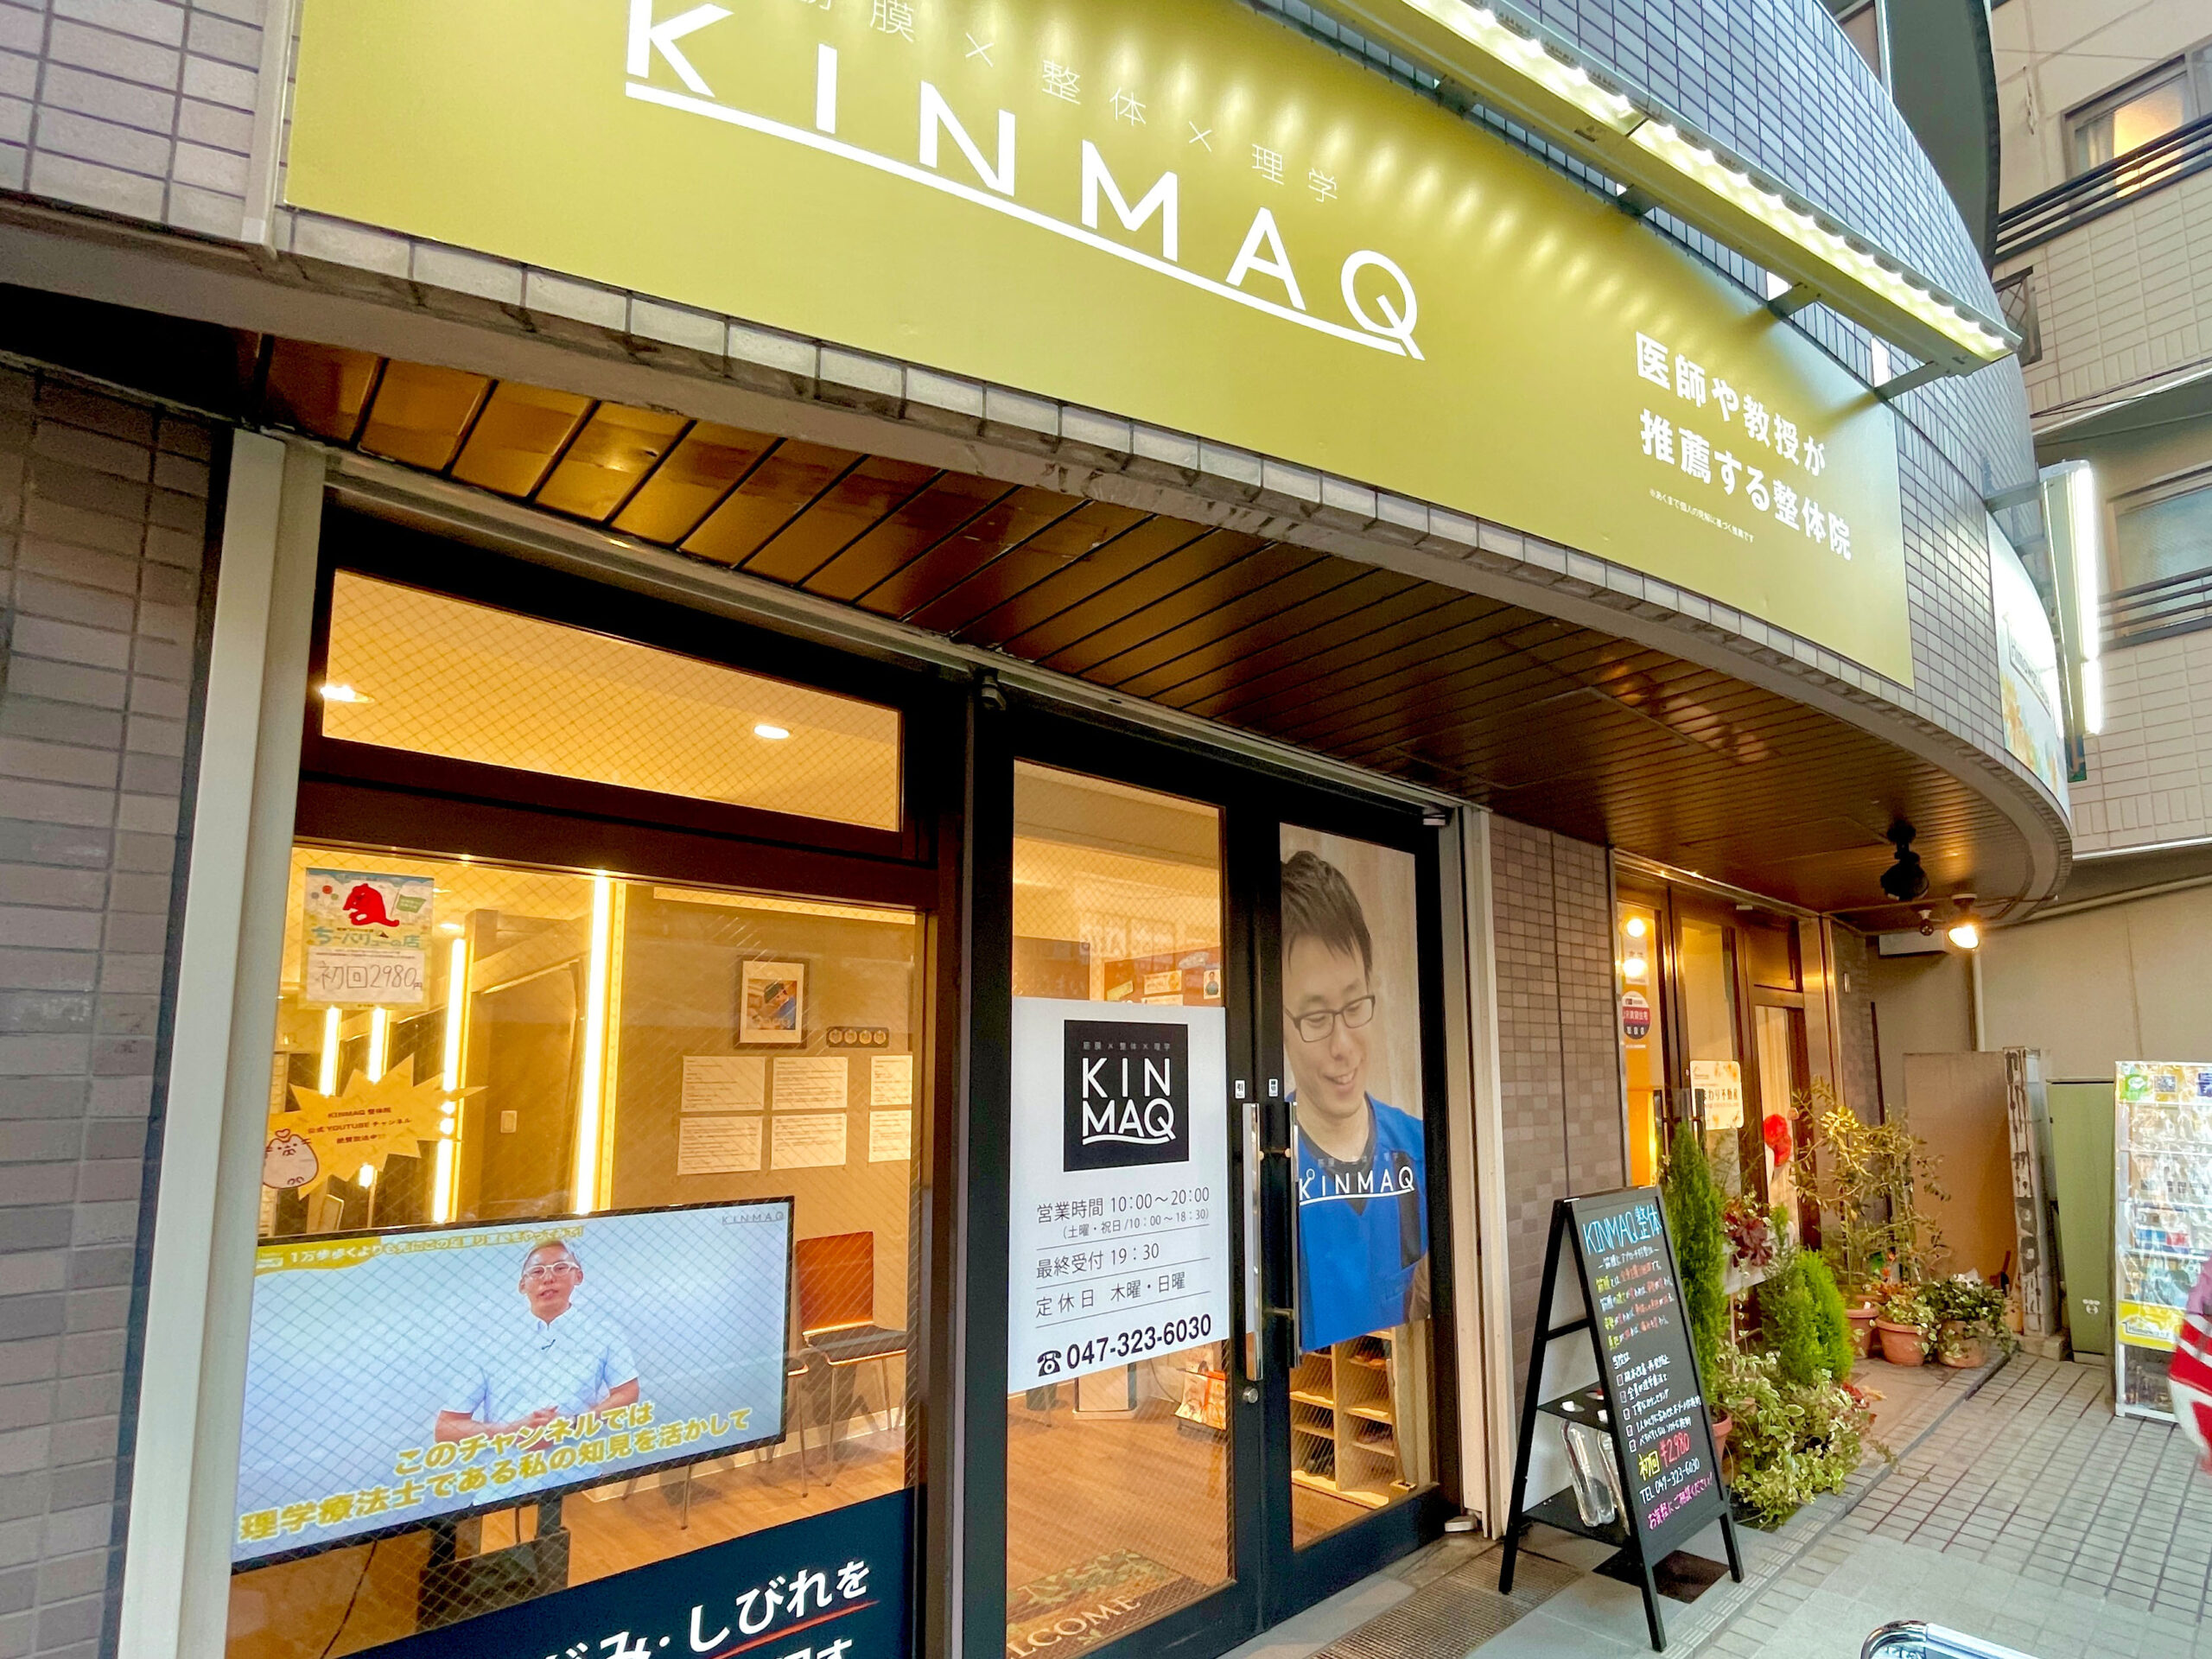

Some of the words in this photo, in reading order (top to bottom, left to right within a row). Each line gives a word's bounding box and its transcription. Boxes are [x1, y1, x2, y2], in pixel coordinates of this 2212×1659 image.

[801, 0, 1338, 202] 膜×整体×理学
[626, 0, 1426, 361] KINMAQ
[1636, 331, 1826, 476] 医師や教授が
[1640, 408, 1852, 560] 推薦する整体院
[1082, 1057, 1172, 1099] KIN
[1082, 1097, 1177, 1141] MAQ
[1037, 1198, 1104, 1224] 営業時間
[1299, 1166, 1415, 1201] KINMAQ
[1036, 1250, 1104, 1279] 最終受付
[1036, 1288, 1095, 1319] 定休日
[1110, 1271, 1185, 1302] 木曜・日曜
[1066, 1313, 1212, 1370] 047-323-6030
[394, 1400, 655, 1476] このチャンネルでは
[237, 1408, 753, 1543] 理学療法士である私の知見を活かして
[1639, 1485, 1656, 1504] TEL
[544, 1560, 871, 1659] み・しびれを
[1007, 1595, 1141, 1659] LCOME
